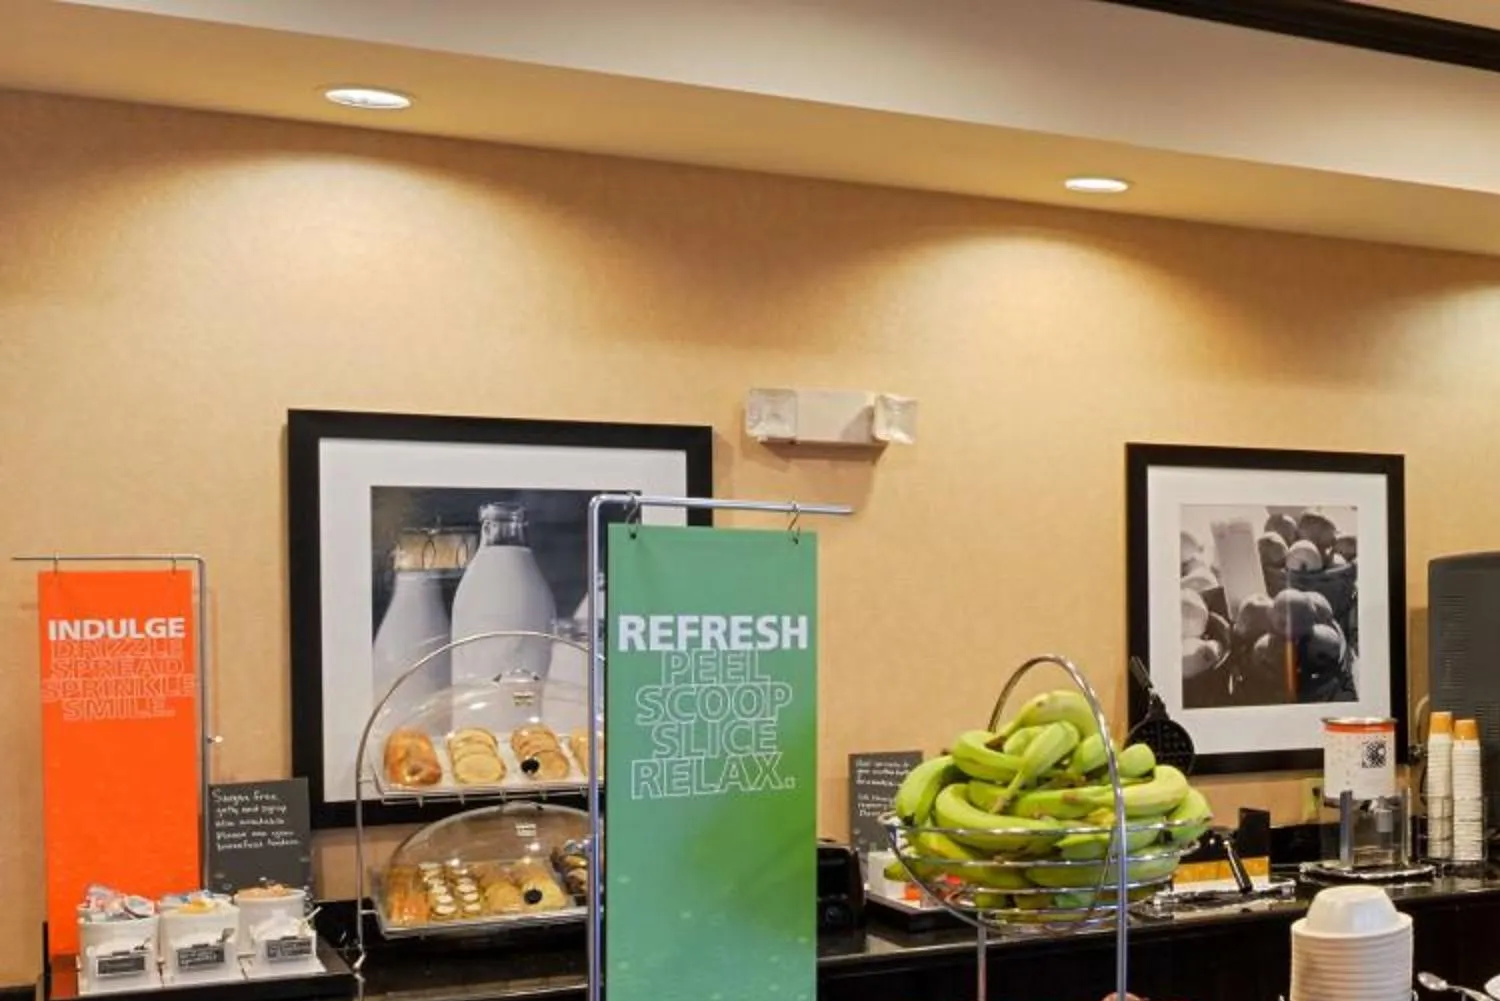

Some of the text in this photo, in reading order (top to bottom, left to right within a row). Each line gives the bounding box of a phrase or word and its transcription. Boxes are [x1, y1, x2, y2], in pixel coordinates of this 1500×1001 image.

[48, 617, 186, 641] INDULGE
[618, 615, 808, 652] REFRESH
[51, 657, 185, 680] SPREAD
[662, 649, 771, 686] PEEL
[42, 673, 195, 702] SPRINKLE
[635, 682, 793, 725] SCOOP
[652, 718, 778, 760] SLICE
[631, 752, 796, 799] RELAX.
